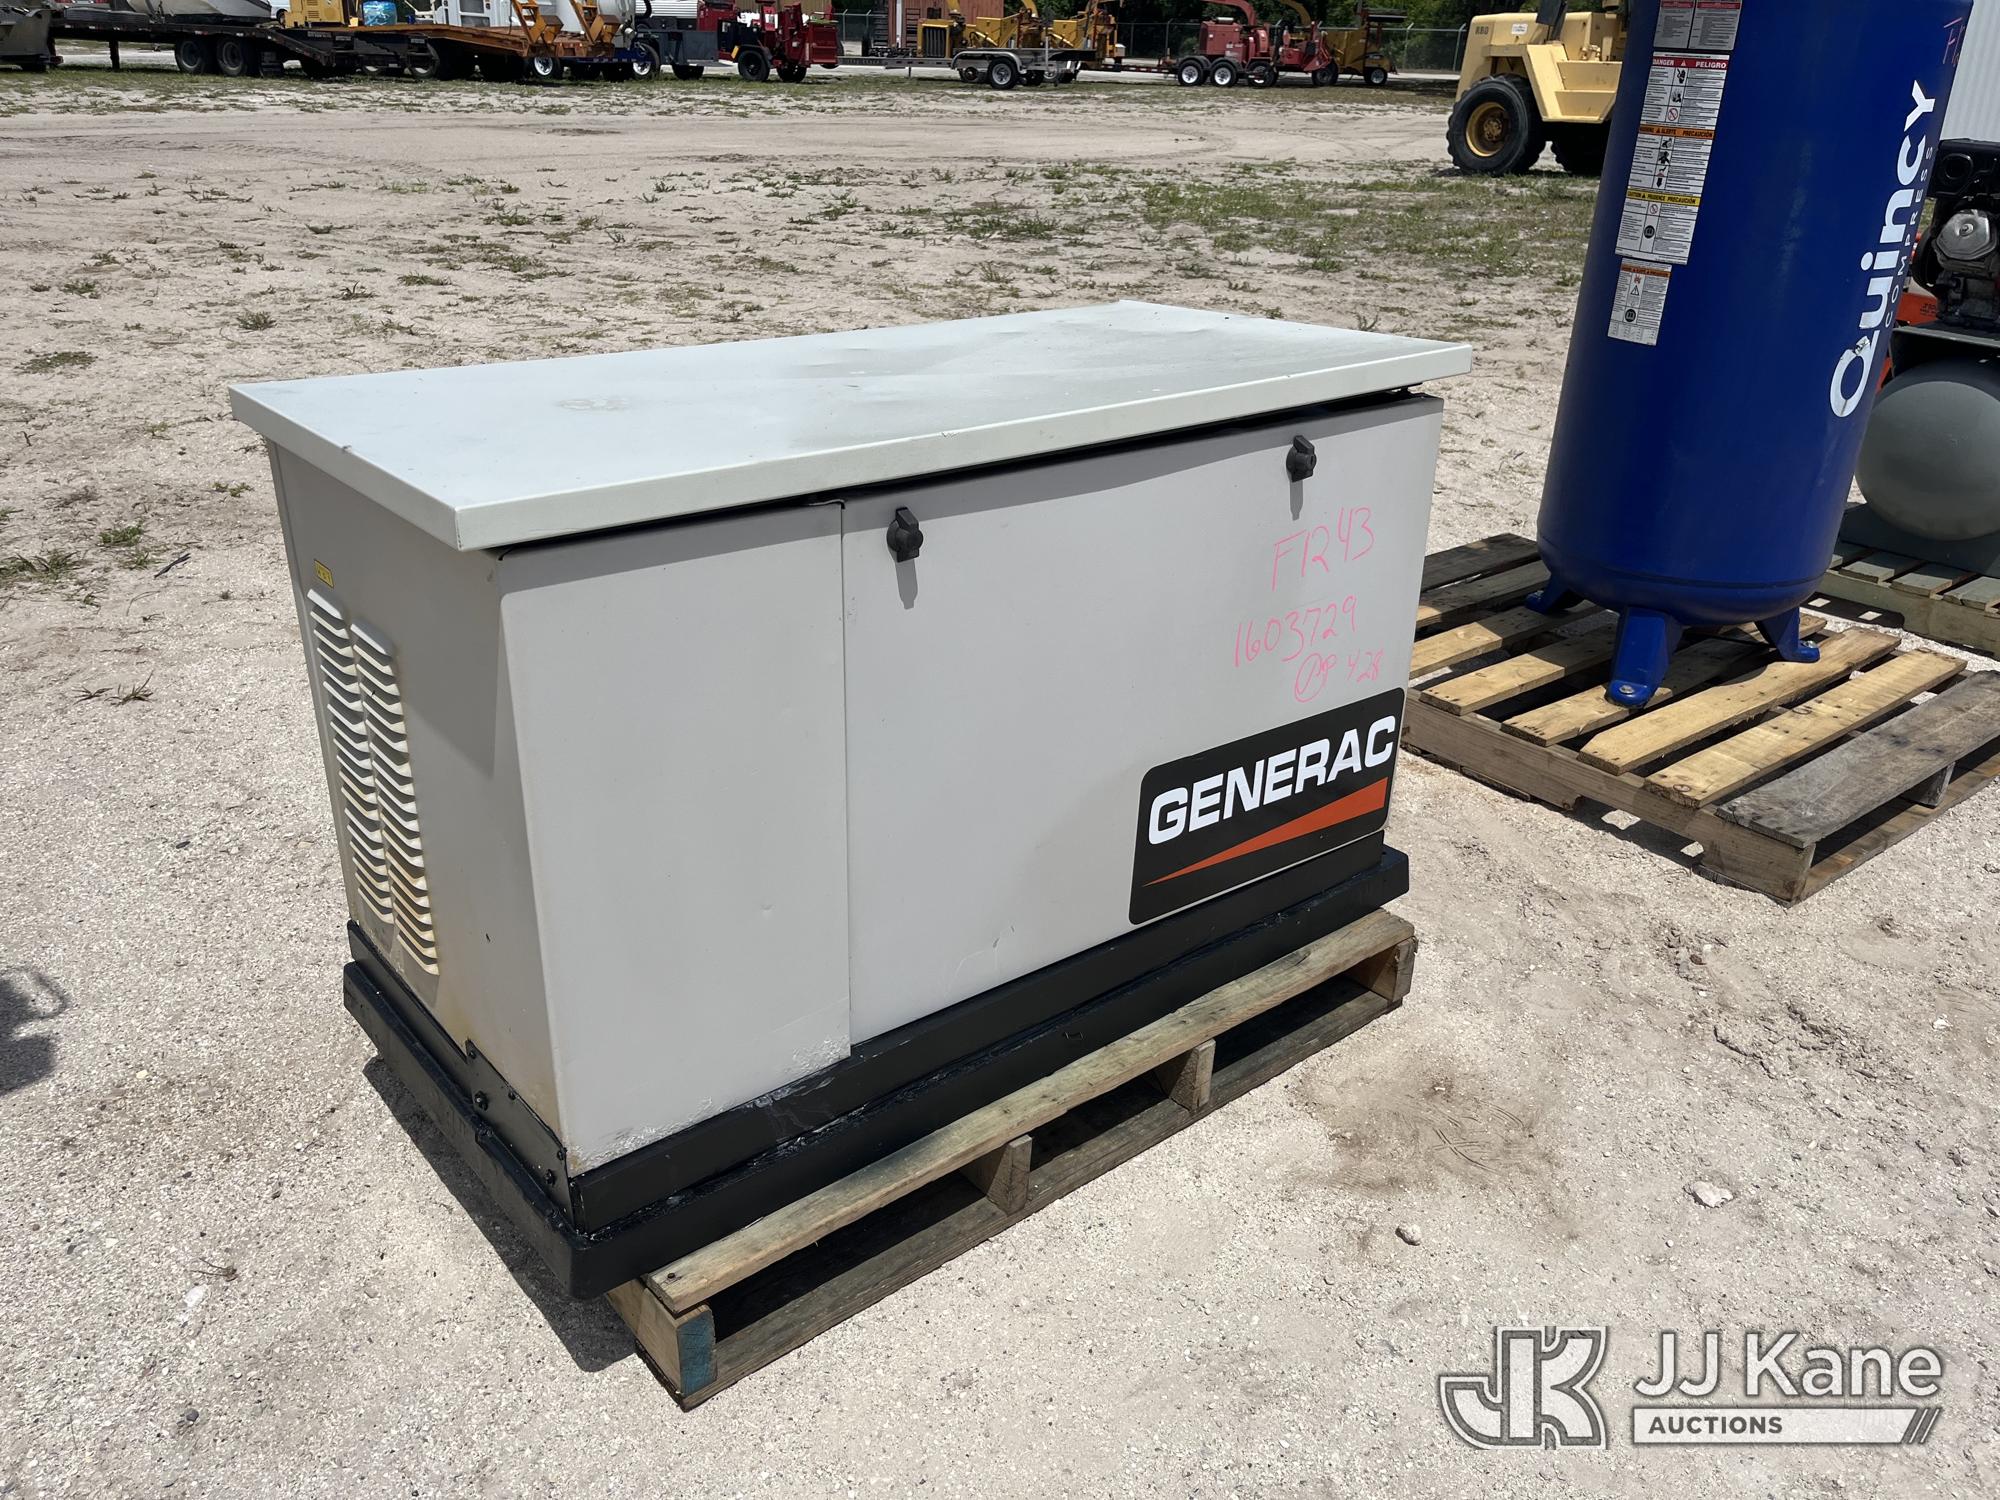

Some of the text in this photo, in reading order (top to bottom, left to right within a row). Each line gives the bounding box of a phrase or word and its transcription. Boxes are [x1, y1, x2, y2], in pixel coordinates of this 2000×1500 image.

[1653, 58, 1727, 69] DANGER PELIGRO
[1234, 595, 1357, 668] 1603729
[1149, 715, 1396, 845] GENERAC
